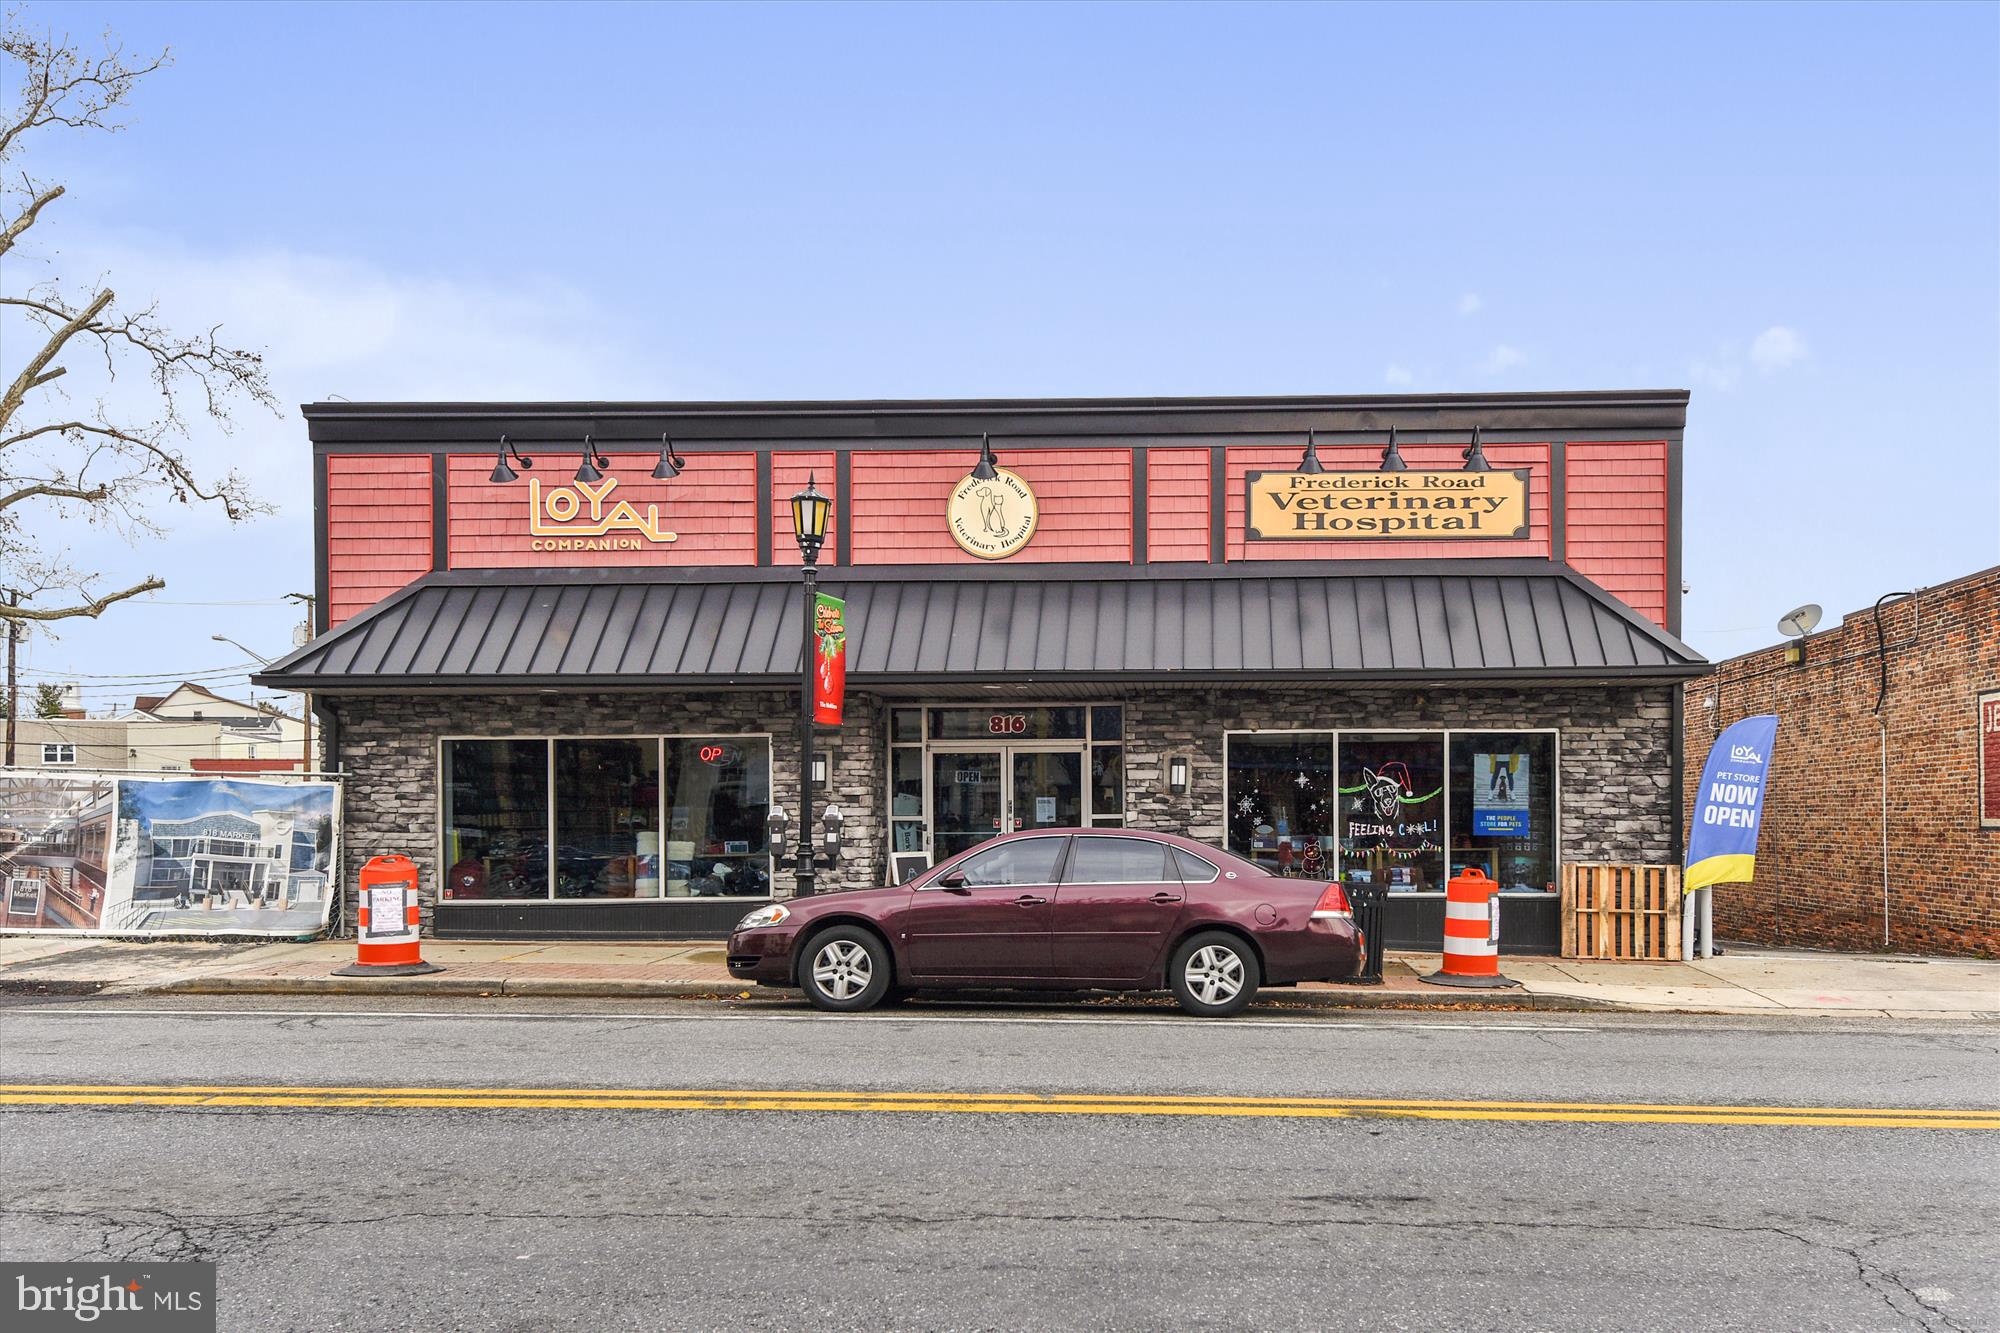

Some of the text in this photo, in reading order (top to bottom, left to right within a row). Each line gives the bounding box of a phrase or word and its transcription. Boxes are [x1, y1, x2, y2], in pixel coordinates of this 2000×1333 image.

[958, 476, 1028, 501] Fredek Road
[1290, 475, 1486, 489] Frederick Road
[530, 478, 678, 542] LOYAL
[1267, 491, 1509, 513] Veterinary
[1292, 511, 1482, 534] Hospital
[955, 515, 1032, 552] Veterinary Hospital
[531, 539, 642, 551] COMPANION
[989, 715, 1026, 733] 816
[1731, 744, 1763, 764] LOYAL
[956, 771, 980, 783] OPEN
[1717, 771, 1760, 784] PET STORE
[1710, 783, 1759, 806] NOW
[1703, 805, 1756, 829] OPEN
[220, 830, 255, 840] MARKET
[1349, 822, 1394, 839] FEELING
